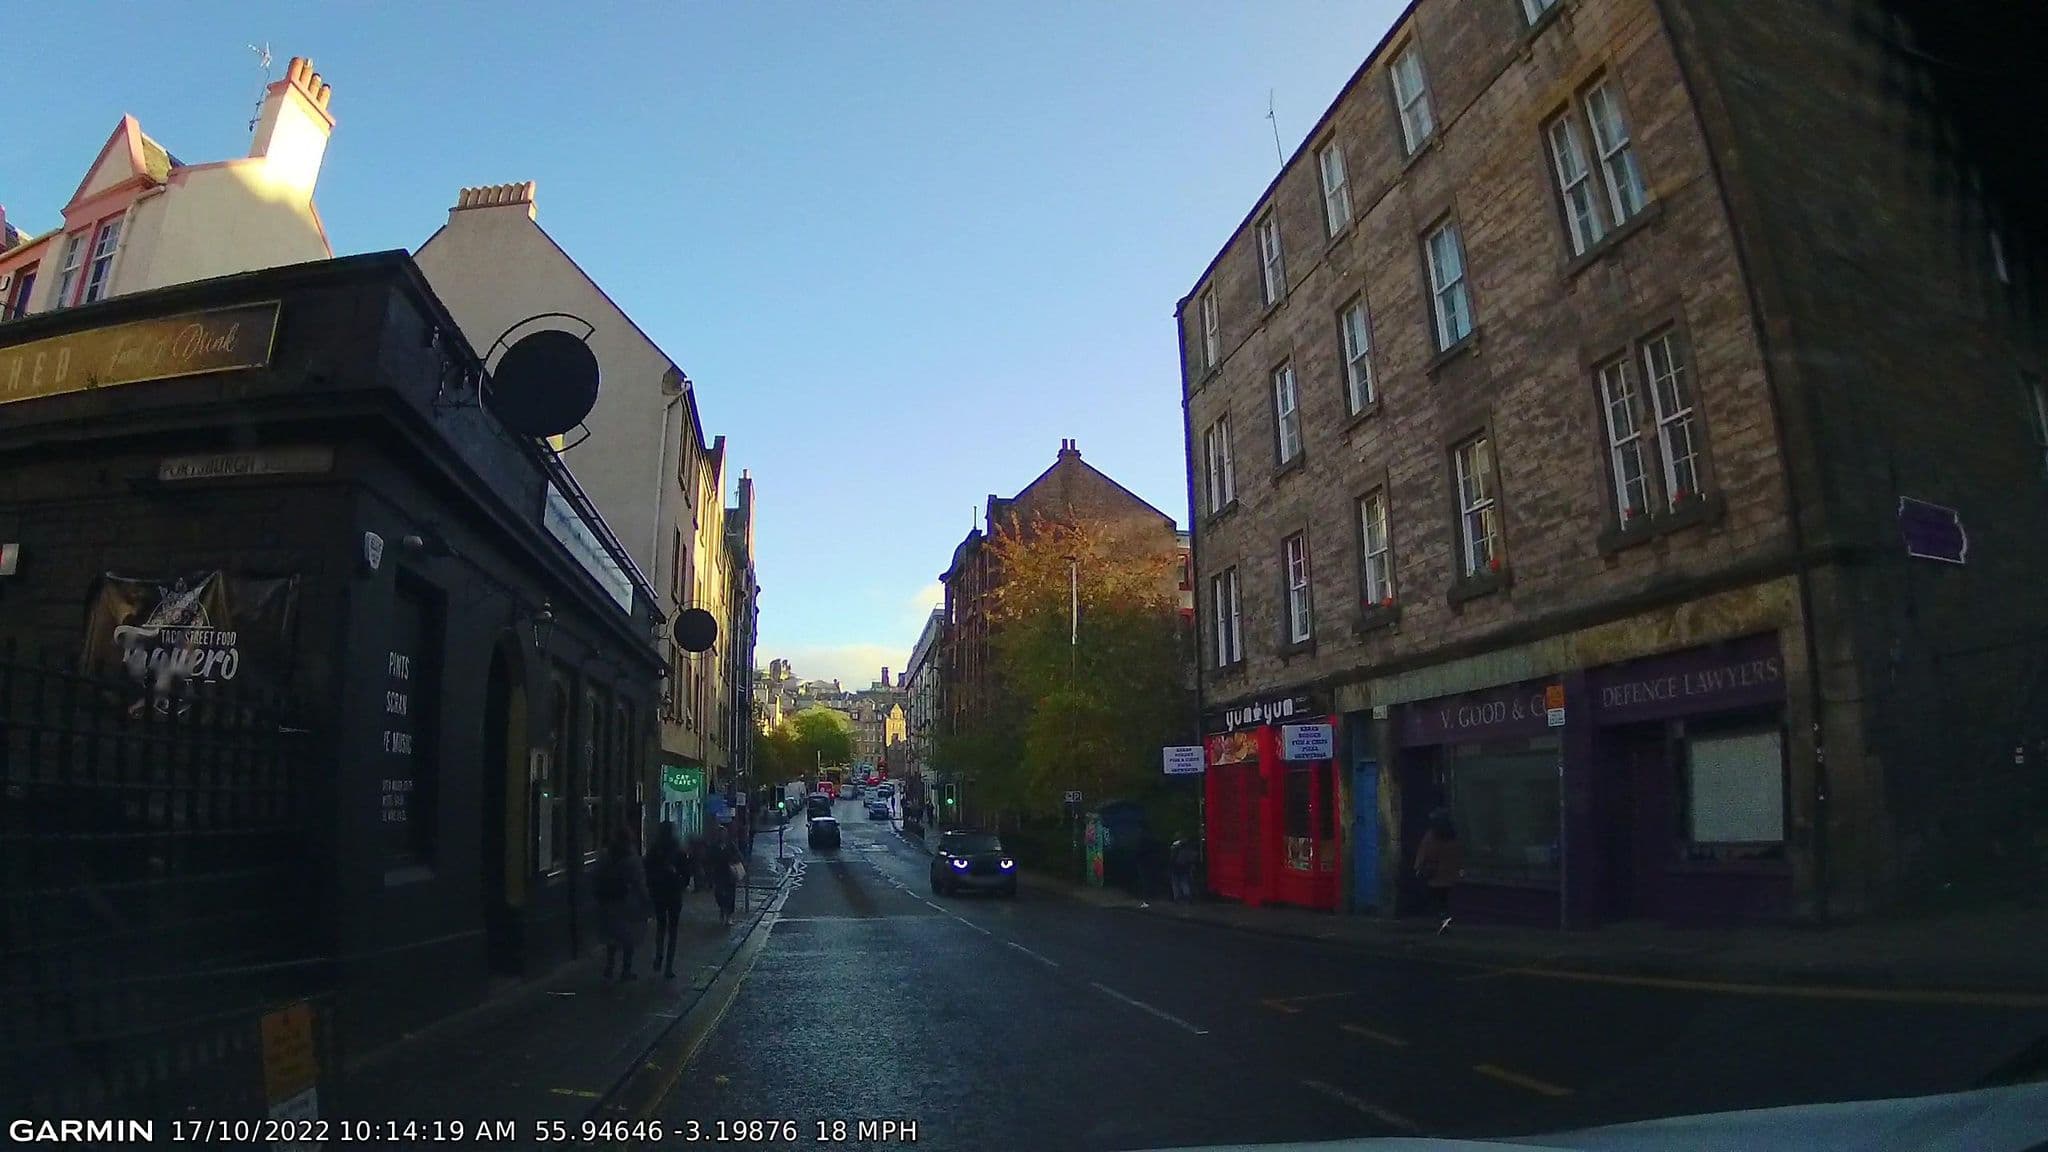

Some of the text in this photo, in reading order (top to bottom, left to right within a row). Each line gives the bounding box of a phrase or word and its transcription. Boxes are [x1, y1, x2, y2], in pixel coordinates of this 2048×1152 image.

[389, 651, 409, 681] PINTS
[1601, 676, 1677, 708] DEFENCE
[1684, 657, 1778, 697] LAWYERS
[1226, 706, 1253, 732] yum
[1264, 698, 1293, 725] yum
[1458, 701, 1506, 728] GOOD
[1512, 699, 1525, 721] &
